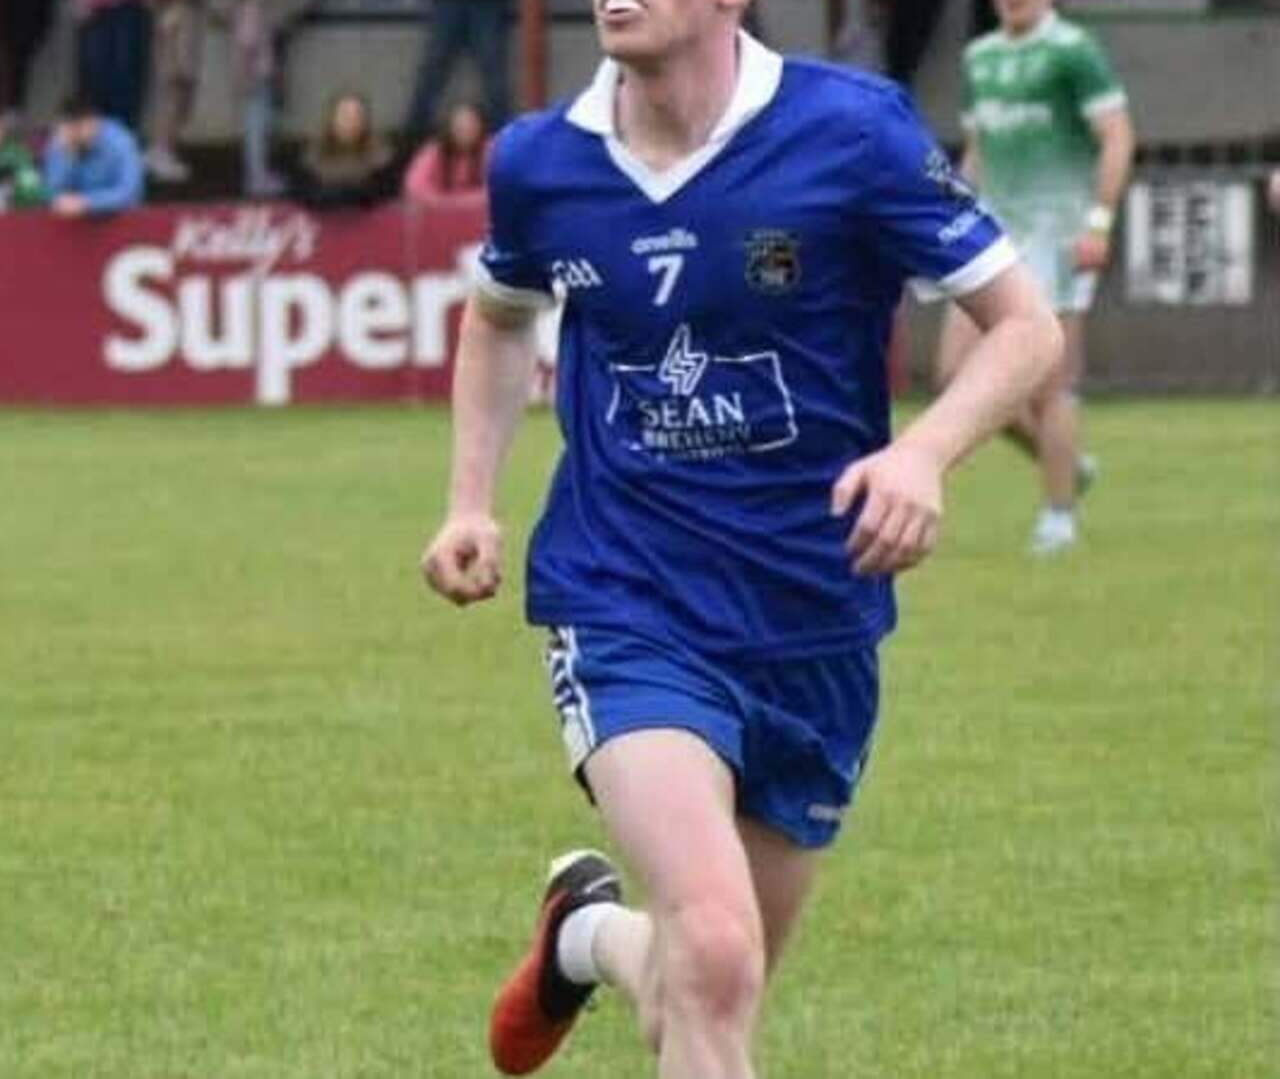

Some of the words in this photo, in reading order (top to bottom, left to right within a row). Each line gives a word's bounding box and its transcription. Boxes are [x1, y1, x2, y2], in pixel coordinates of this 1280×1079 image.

[173, 209, 319, 273] Kelly's
[646, 254, 685, 307] 7
[638, 391, 745, 431] SEAN
